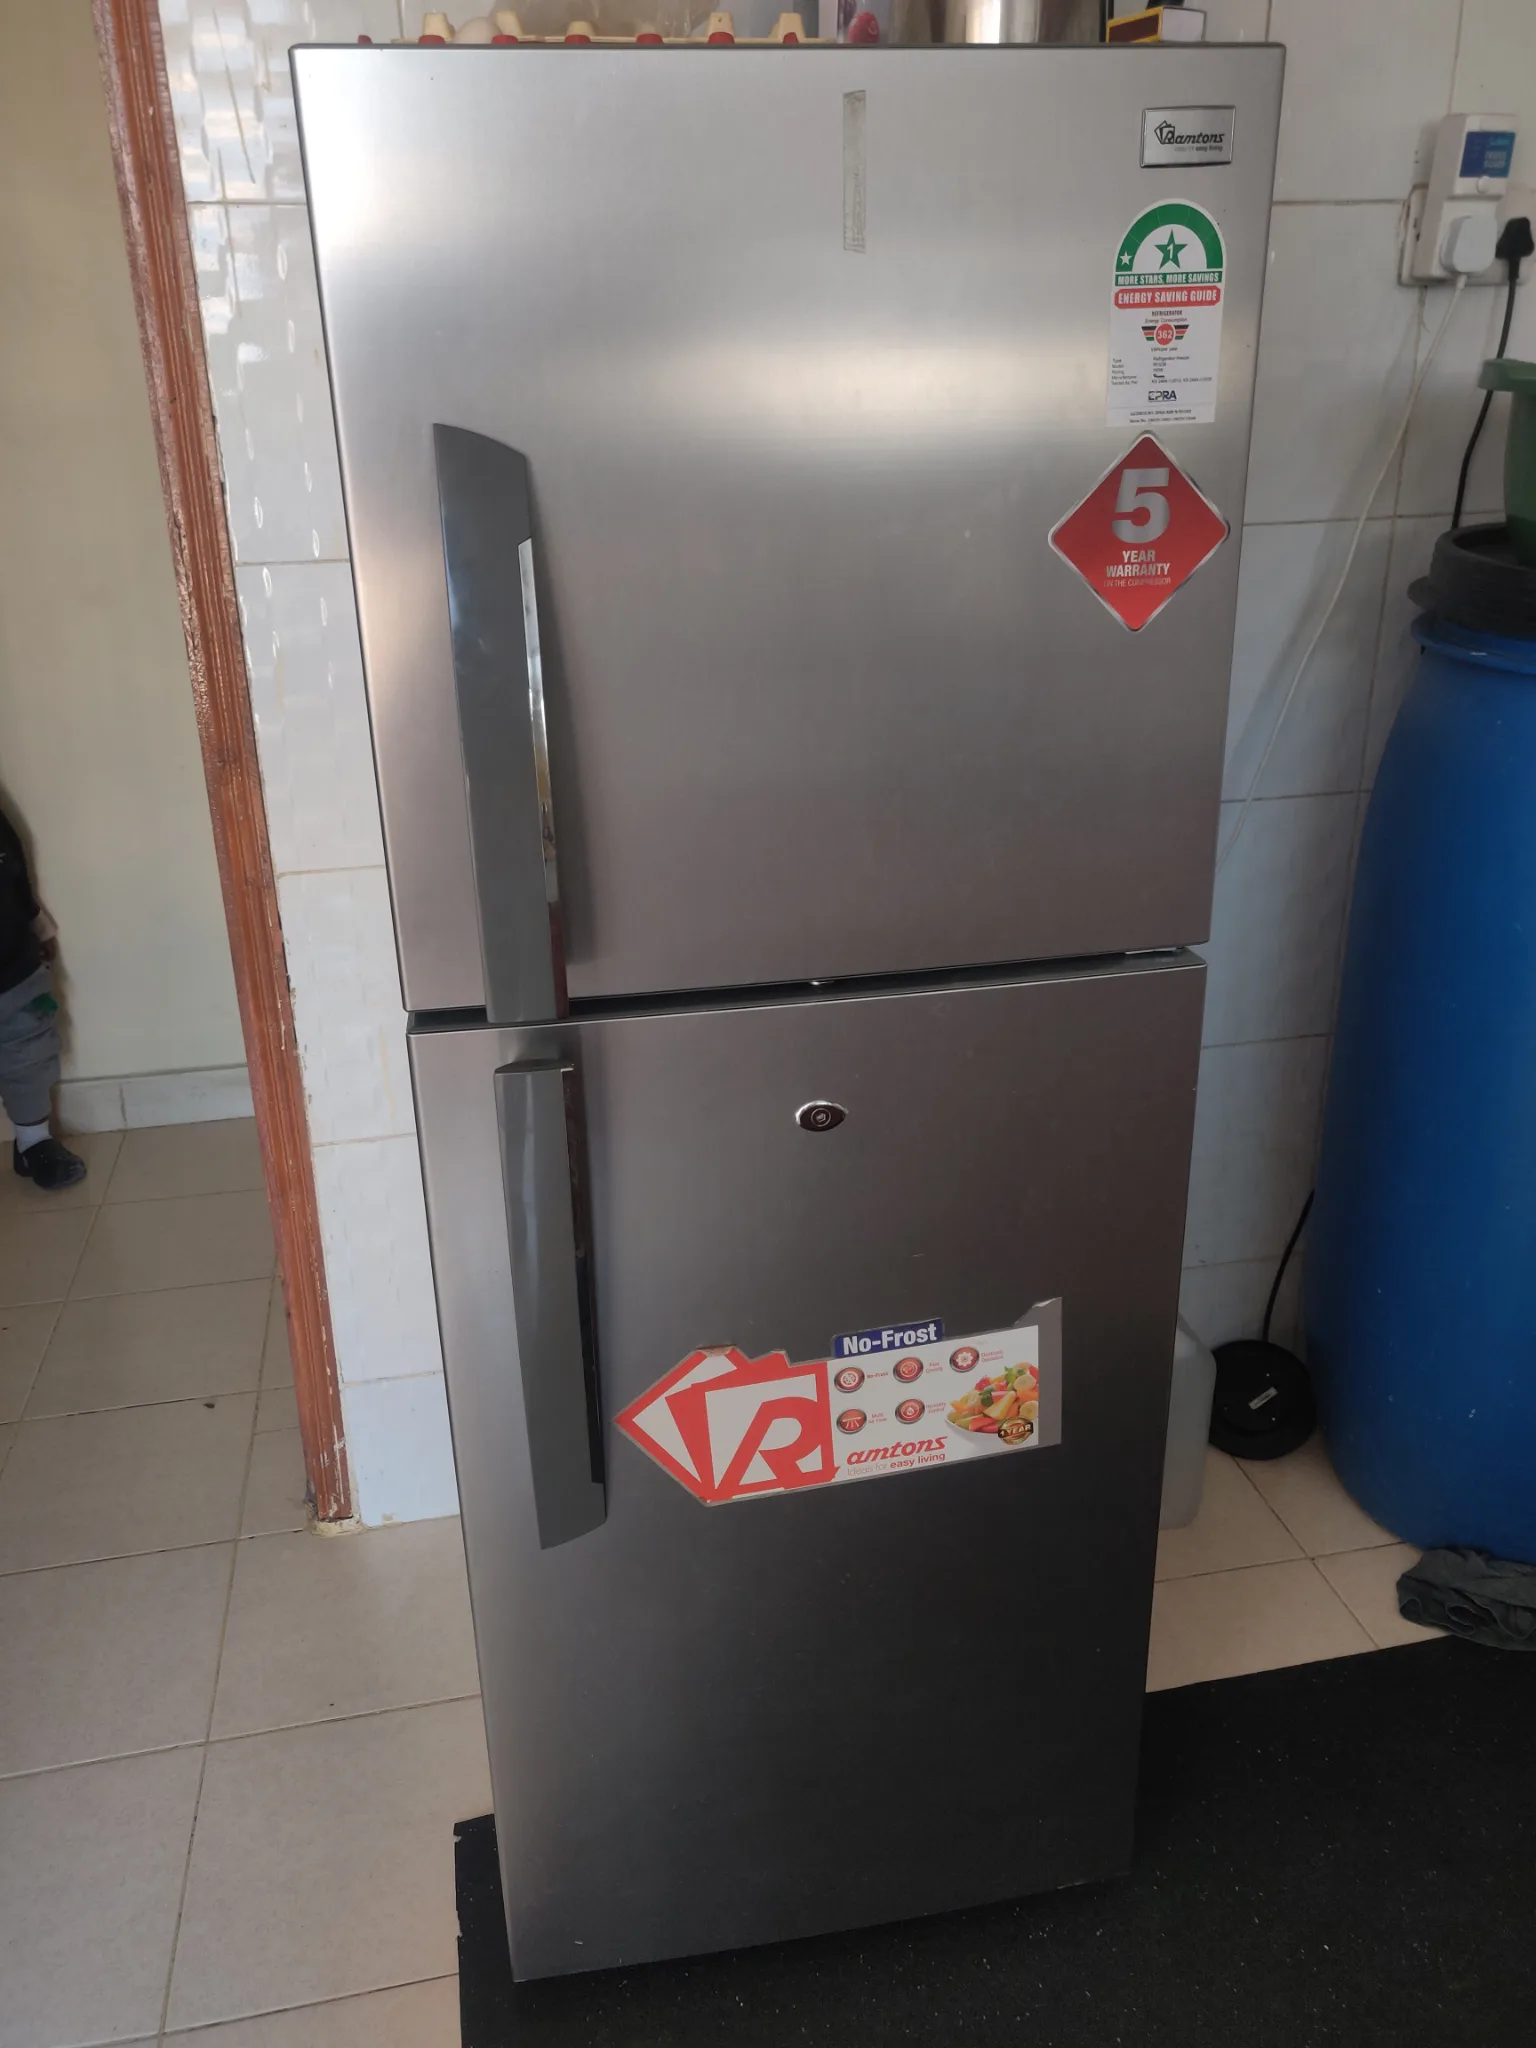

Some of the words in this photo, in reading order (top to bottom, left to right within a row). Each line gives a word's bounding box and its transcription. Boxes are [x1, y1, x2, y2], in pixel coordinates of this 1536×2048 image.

[1163, 129, 1225, 145] Ramtons
[1166, 243, 1174, 260] 1
[1117, 275, 1138, 286] MORE
[1165, 273, 1187, 284] MORE
[1188, 272, 1219, 283] SAVINGS
[1118, 292, 1152, 304] ENERGY
[1154, 290, 1188, 303] SAVING
[1190, 289, 1217, 302] GUIDE
[1157, 330, 1173, 339] 362
[1111, 467, 1171, 544] 5
[1122, 549, 1156, 563] YEAR
[1106, 563, 1171, 577] WARRANTY
[1114, 578, 1126, 587] THE
[843, 1323, 937, 1355] No-Frost
[1007, 1423, 1031, 1435] YEAR
[846, 1436, 948, 1465] amtons
[890, 1459, 915, 1469] easy
[918, 1453, 946, 1464] living
